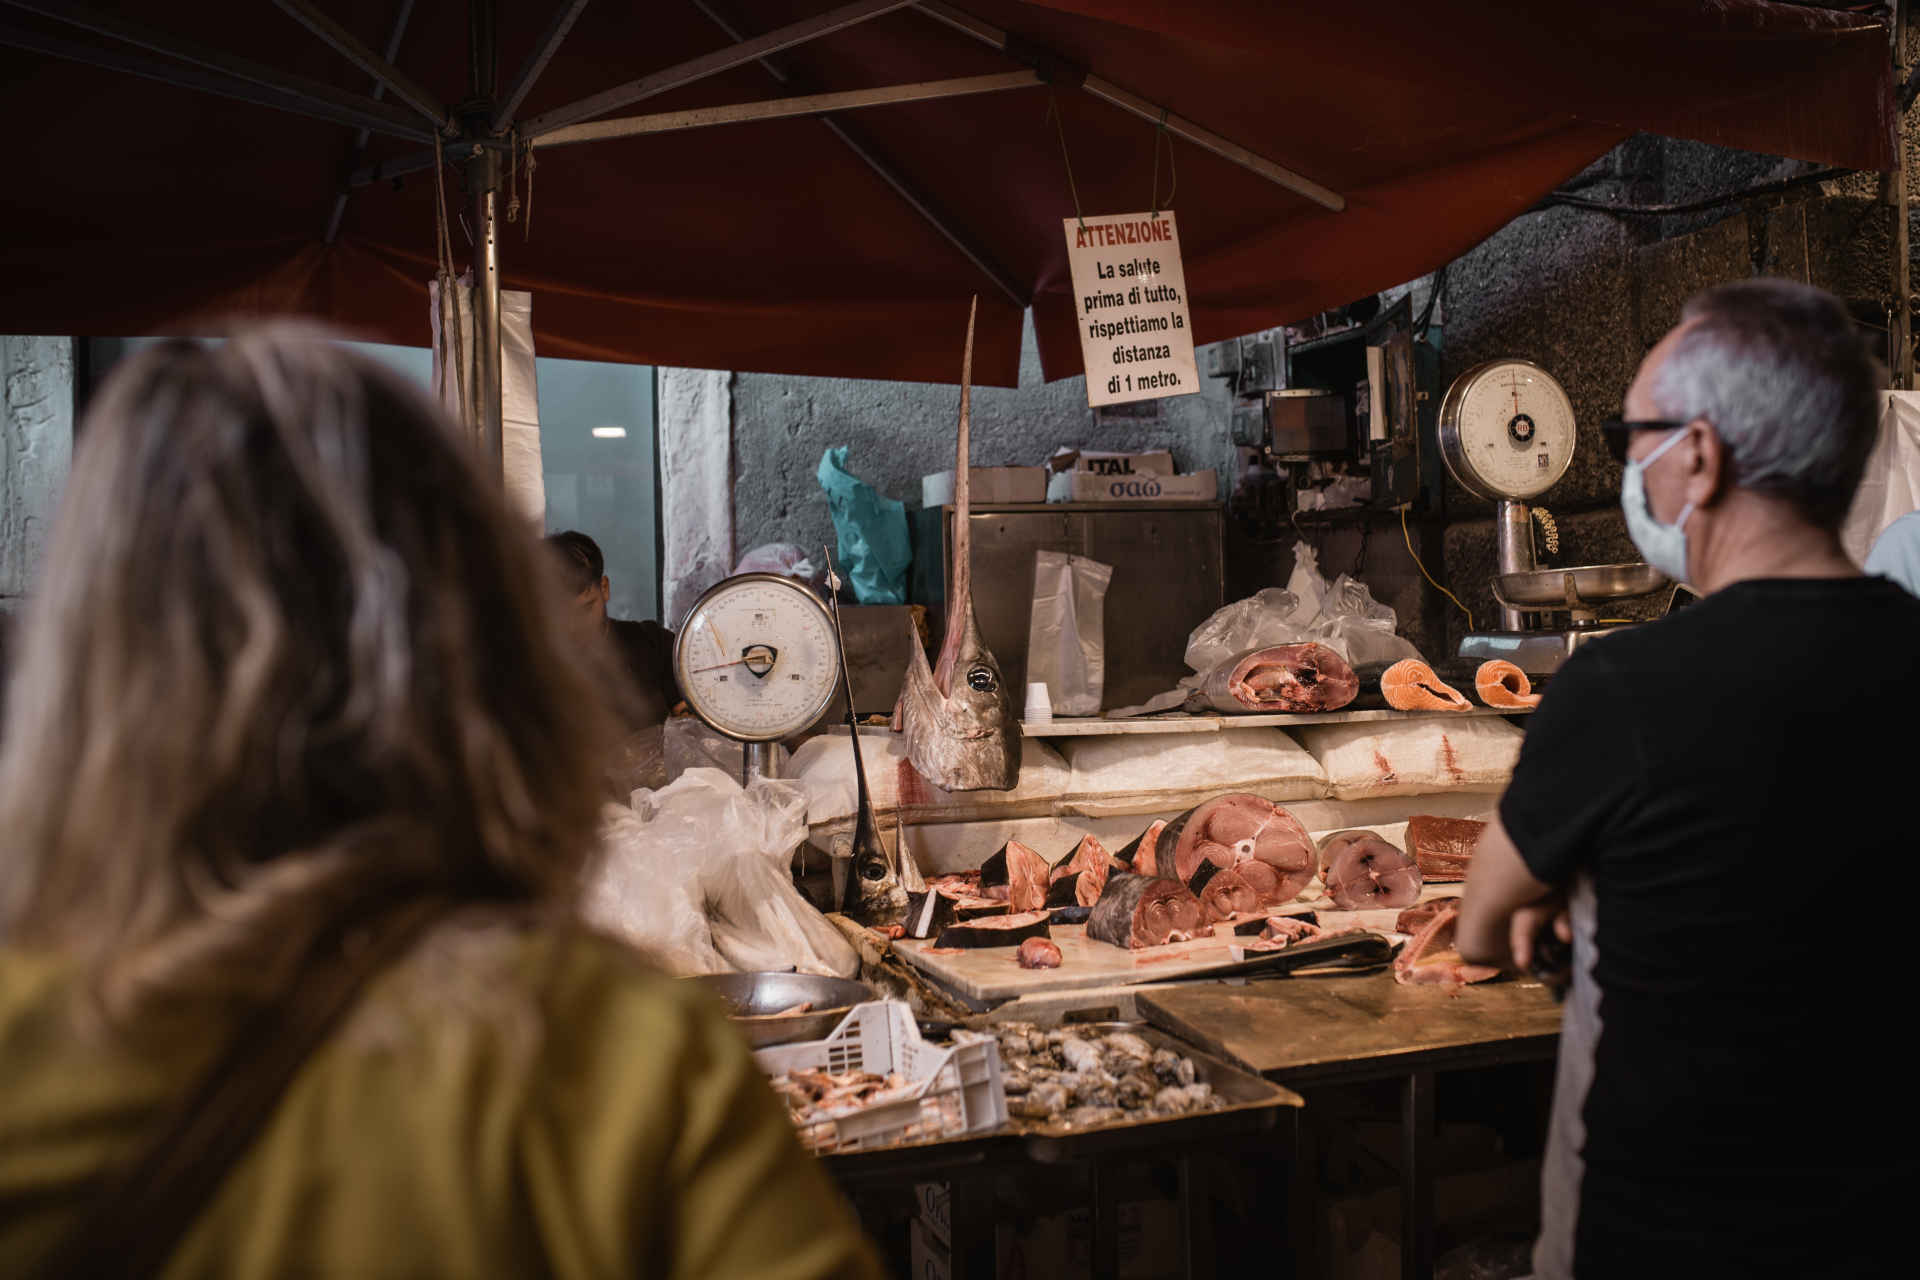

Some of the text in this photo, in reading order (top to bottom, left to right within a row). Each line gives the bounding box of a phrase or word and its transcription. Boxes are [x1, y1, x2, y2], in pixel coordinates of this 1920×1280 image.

[1076, 220, 1172, 248] ATTENZIONE
[1097, 258, 1160, 279] La salute
[1084, 285, 1181, 313] prima di tutto,
[1089, 312, 1184, 340] rispettiamo la
[1112, 344, 1170, 364] distanza
[1108, 372, 1181, 394] di 1 metro.
